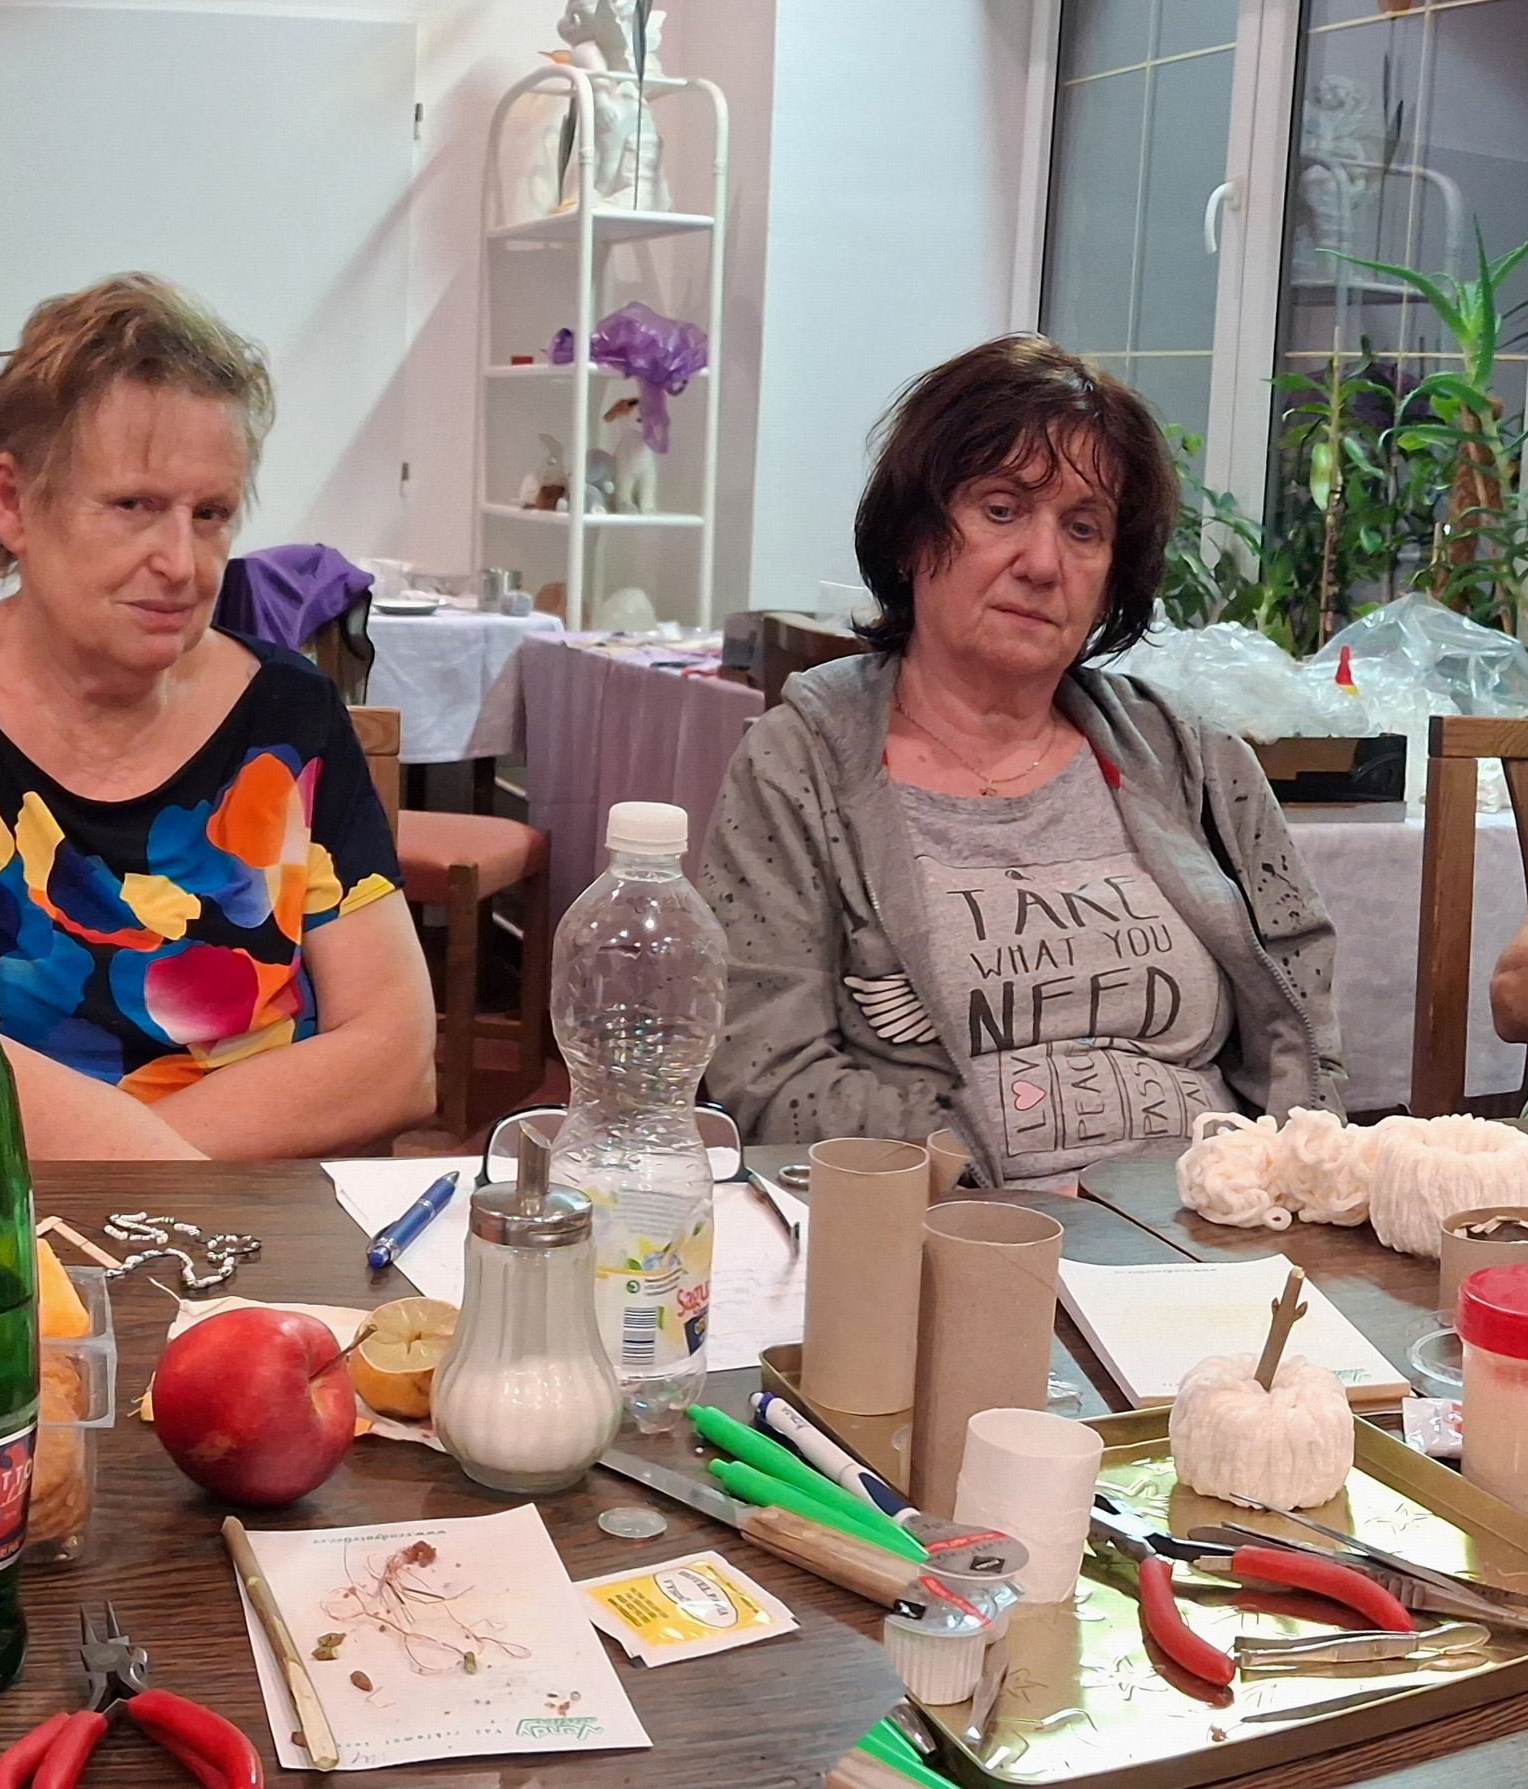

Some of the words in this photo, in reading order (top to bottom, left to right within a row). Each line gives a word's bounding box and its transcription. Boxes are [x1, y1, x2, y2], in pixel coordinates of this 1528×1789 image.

[946, 874, 1160, 941] TAKE
[969, 936, 1076, 979] WHAT
[1102, 923, 1173, 959] YOU
[968, 965, 1181, 1058] NEED
